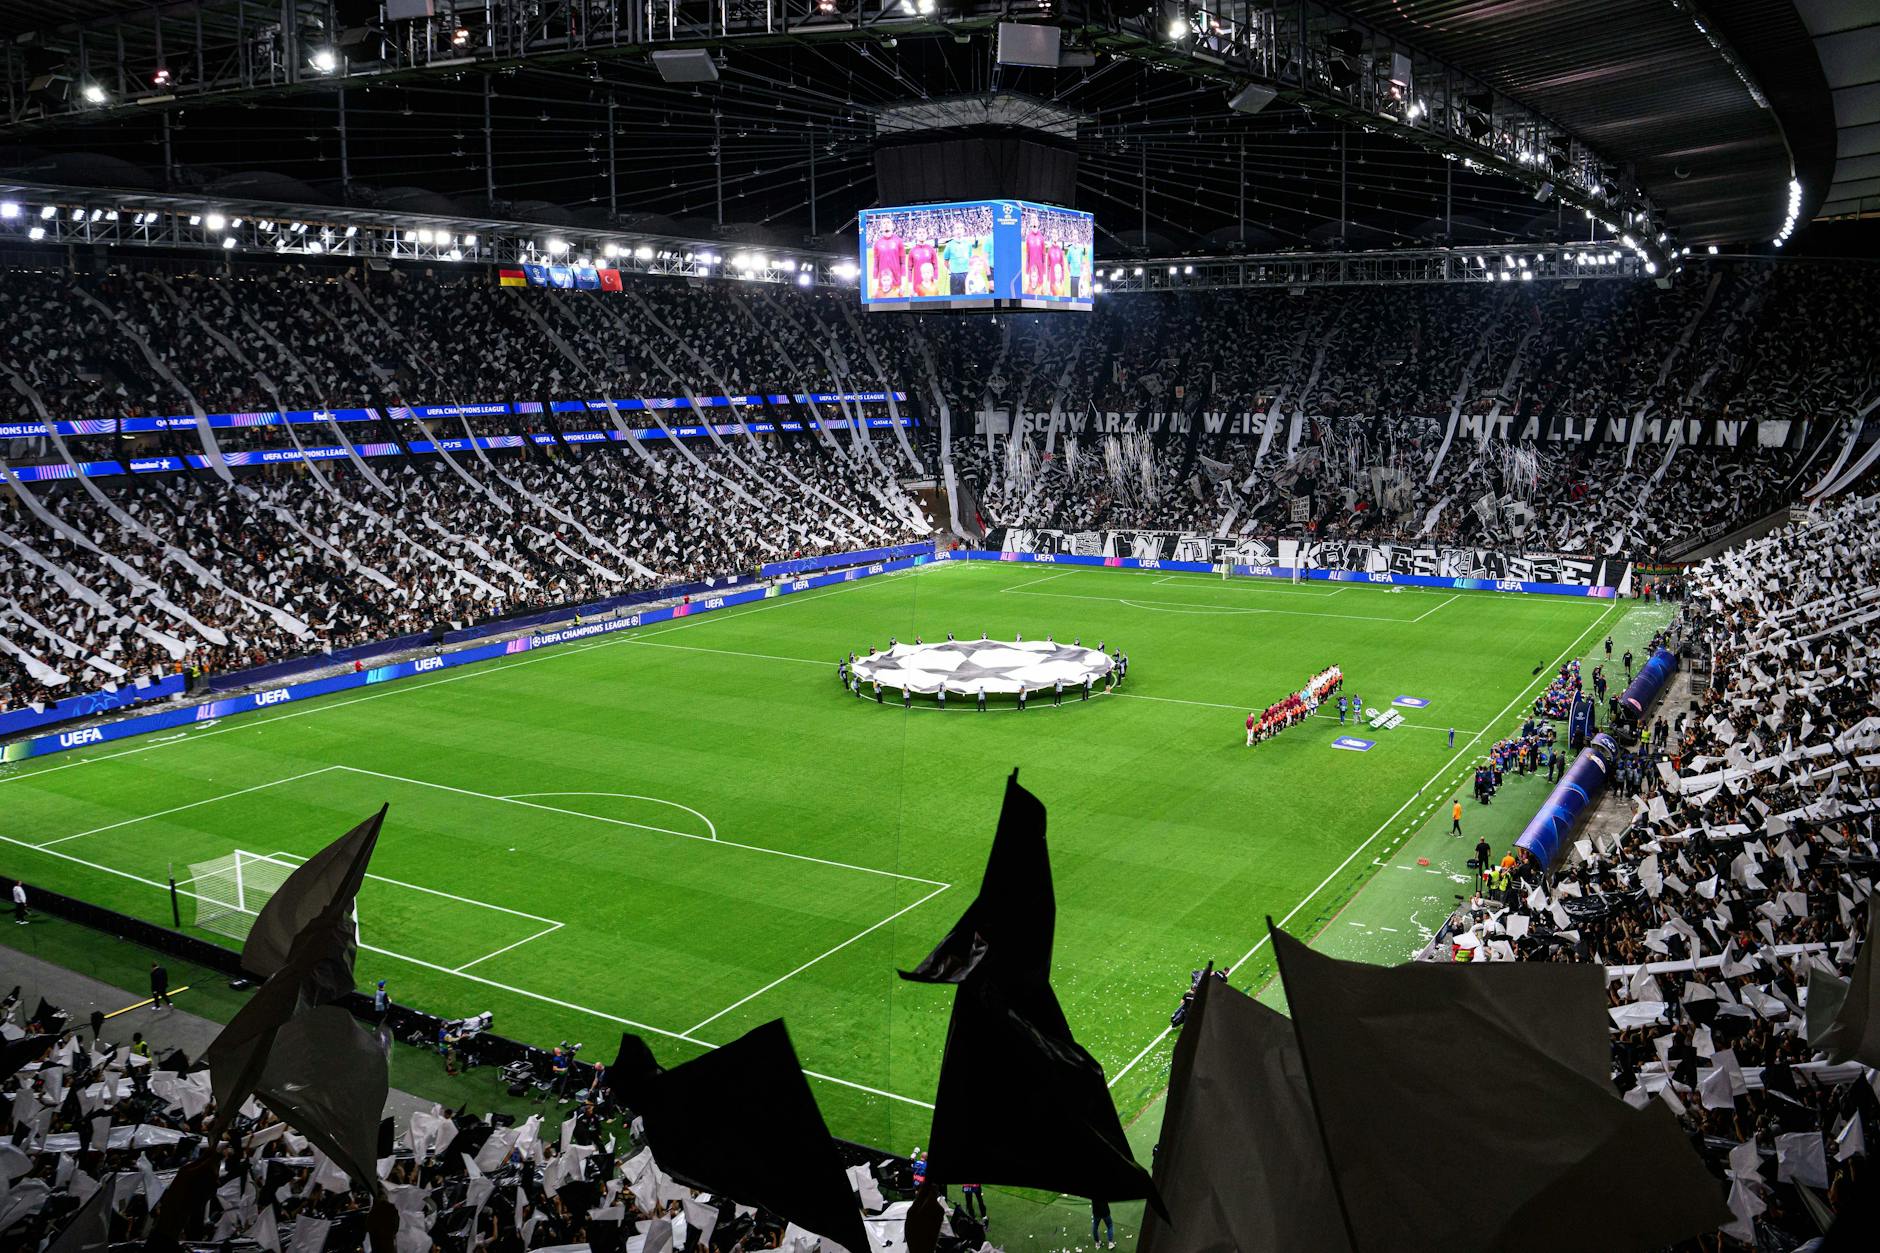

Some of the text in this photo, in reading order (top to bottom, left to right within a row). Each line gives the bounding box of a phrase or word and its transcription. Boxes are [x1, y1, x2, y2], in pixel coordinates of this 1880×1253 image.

[427, 407, 443, 415] UEFA
[481, 405, 504, 413] LEAGUE
[935, 551, 951, 560] UEFA
[1034, 553, 1055, 562] UEFA
[1139, 559, 1160, 568] UEFA
[868, 565, 883, 574] UEFA
[1249, 566, 1272, 575] UEFA
[1368, 572, 1393, 582] UEFA
[792, 580, 809, 590] UEFA
[1496, 580, 1523, 591] UEFA
[705, 597, 724, 609] UEFA
[541, 617, 631, 644] UEFA CHAMPIONS LEAGUE
[414, 656, 444, 671] UEFA
[255, 688, 291, 706] UEFA
[60, 727, 103, 747] UEFA
